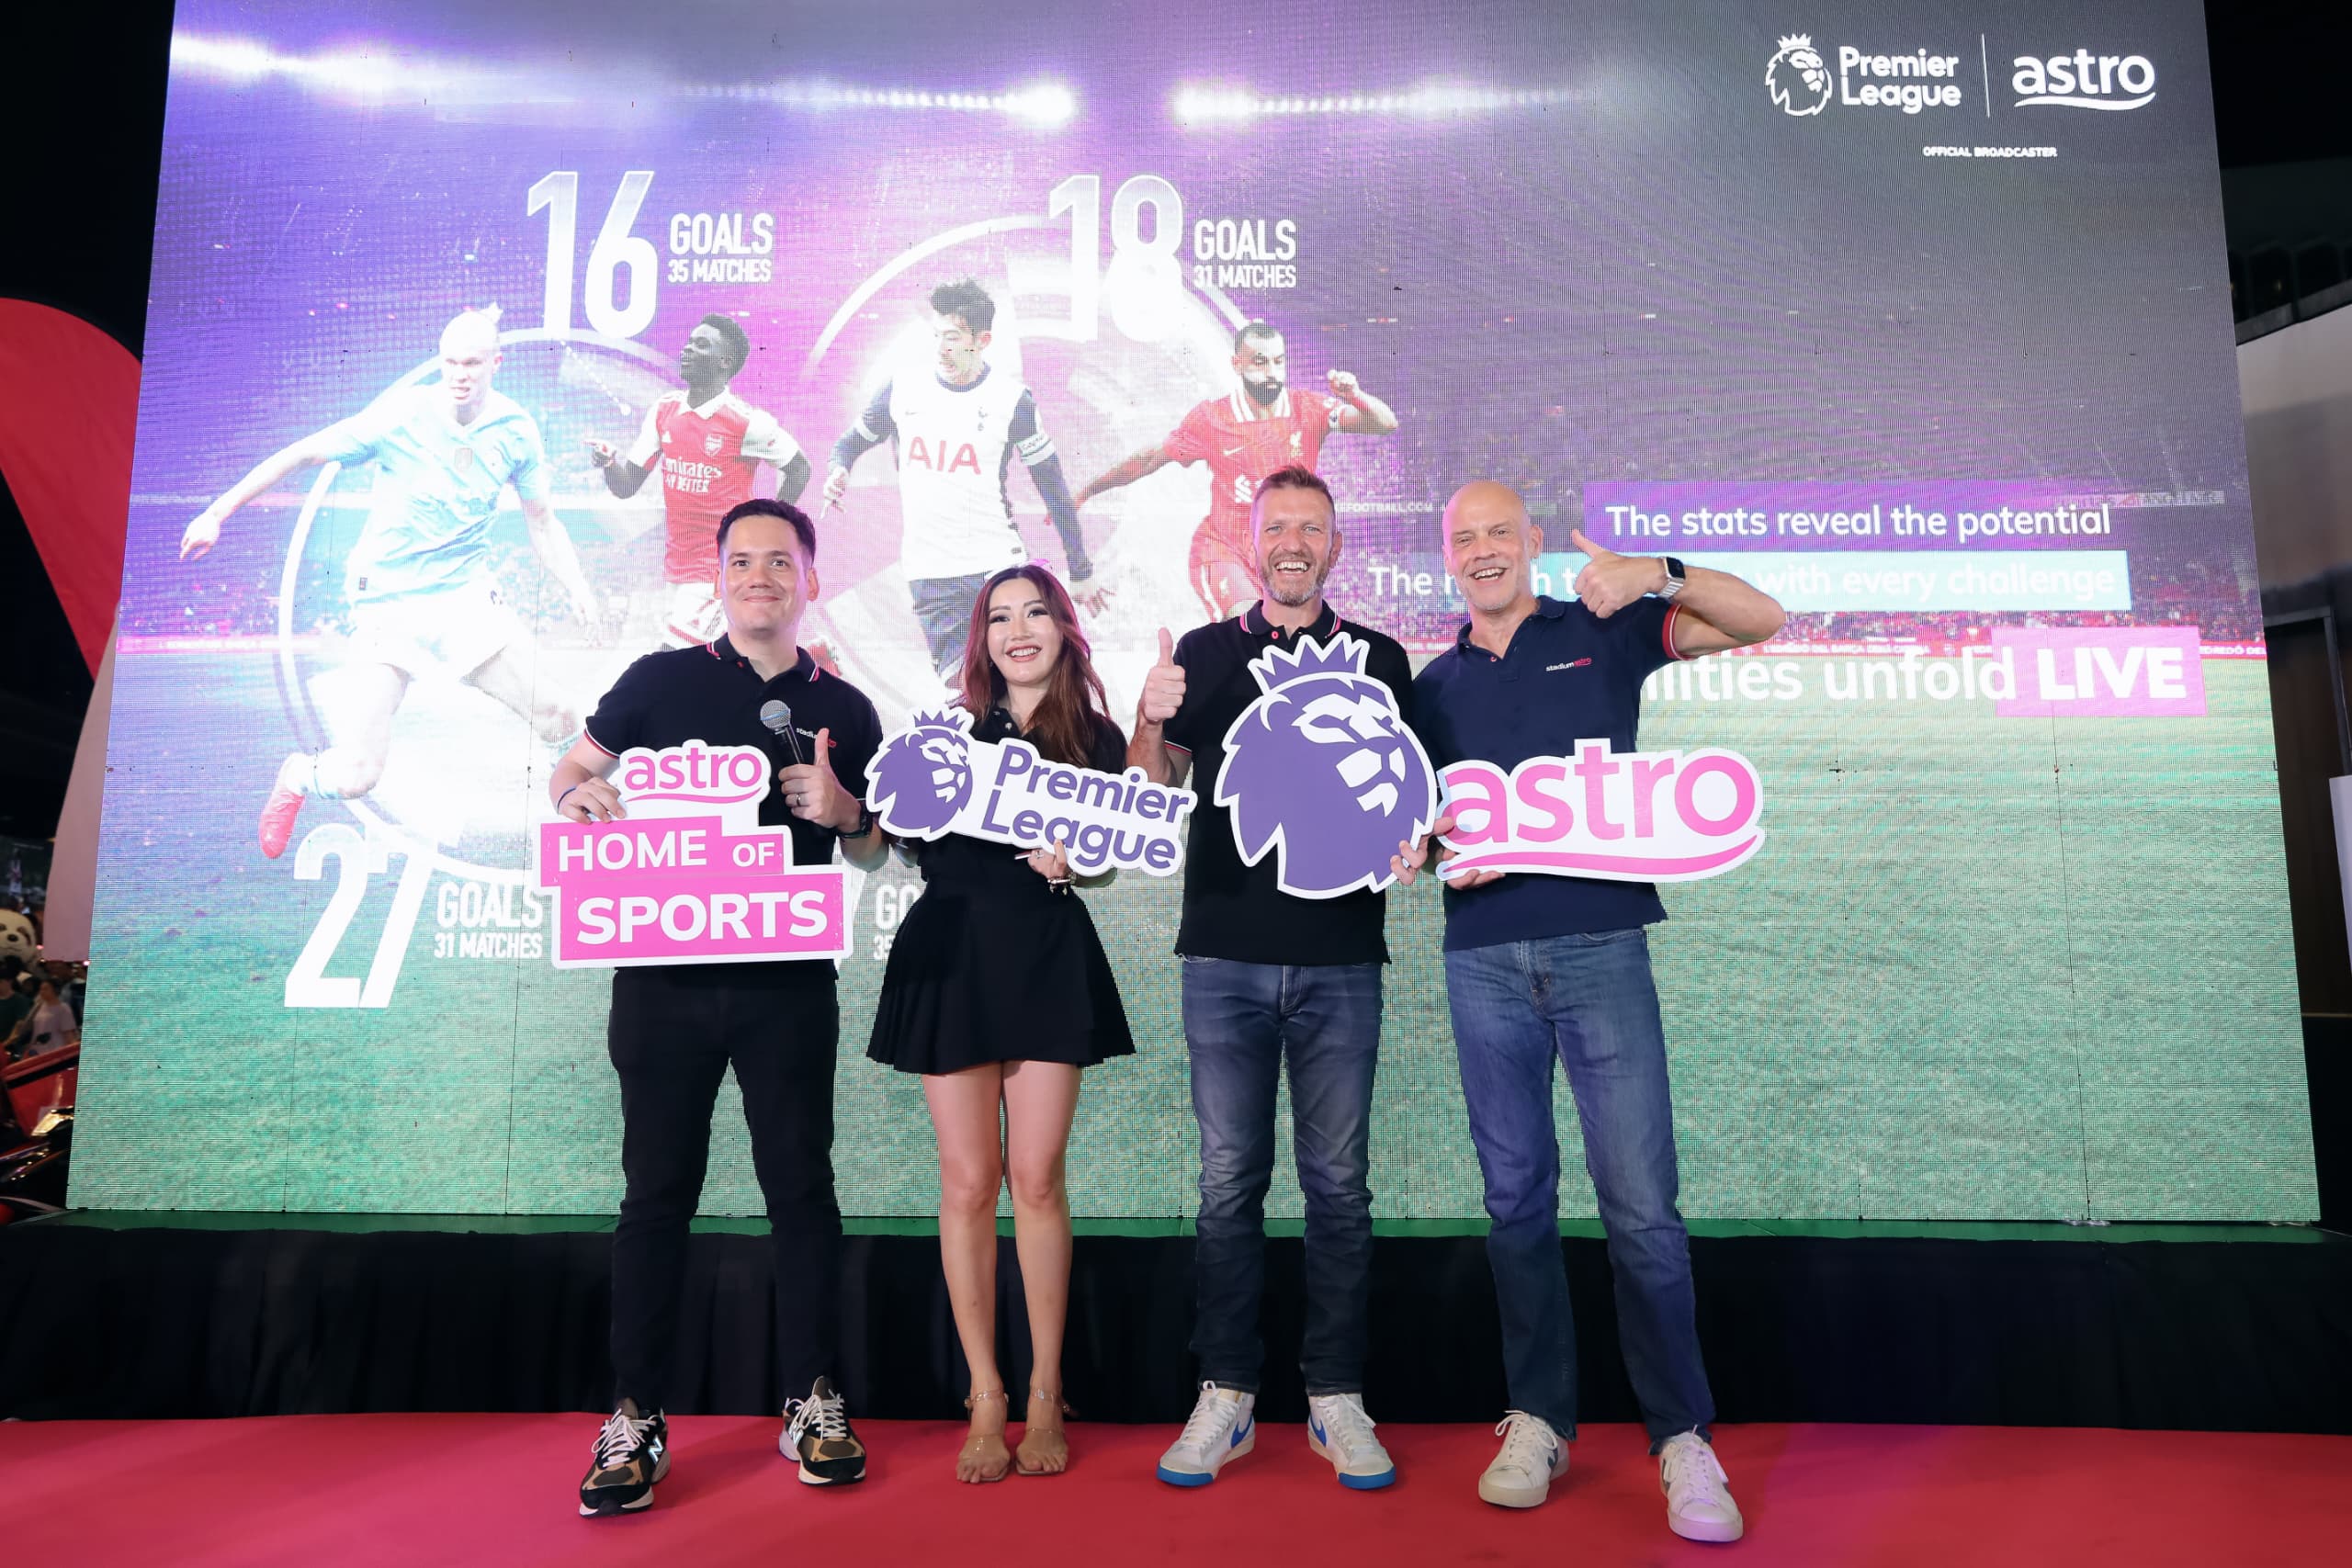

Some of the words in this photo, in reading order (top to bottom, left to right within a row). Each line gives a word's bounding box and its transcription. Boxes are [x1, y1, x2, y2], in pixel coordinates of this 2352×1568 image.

[1839, 46, 1960, 79] Premier
[2012, 49, 2155, 95] astro
[1841, 82, 1962, 114] League
[1923, 147, 1972, 157] OFFICIAL
[1973, 147, 2058, 158] BROADCASTER
[669, 213, 775, 254] GOALS
[1193, 219, 1296, 261] GOALS
[527, 171, 658, 339] 16
[668, 259, 688, 283] 35
[693, 258, 772, 283] MATCHES
[1049, 175, 1183, 344] 18
[1193, 265, 1213, 288] 31
[1218, 265, 1296, 288] MATCHES
[907, 436, 981, 475] AIA
[1606, 505, 1671, 536] The
[1681, 506, 1769, 536] stats
[1778, 504, 1881, 536] reveal
[1890, 505, 1947, 536] the
[1957, 503, 2111, 543] potential
[1368, 566, 1433, 596] The
[1755, 564, 1832, 594] with
[1842, 568, 1936, 602] every
[1947, 562, 2114, 600] challenge
[1824, 645, 2017, 701] unfold
[2038, 647, 2187, 699] LIVE
[624, 748, 762, 790] astro
[995, 745, 1189, 823] Premier
[1442, 745, 1756, 846] astro
[559, 829, 707, 872] HOME
[732, 842, 775, 867] OF
[981, 790, 1176, 869] League
[284, 822, 435, 1008] 27
[436, 881, 544, 928] GOALS
[576, 890, 828, 944] SPORTS
[435, 932, 454, 958] 31
[459, 933, 543, 958] MATCHES
